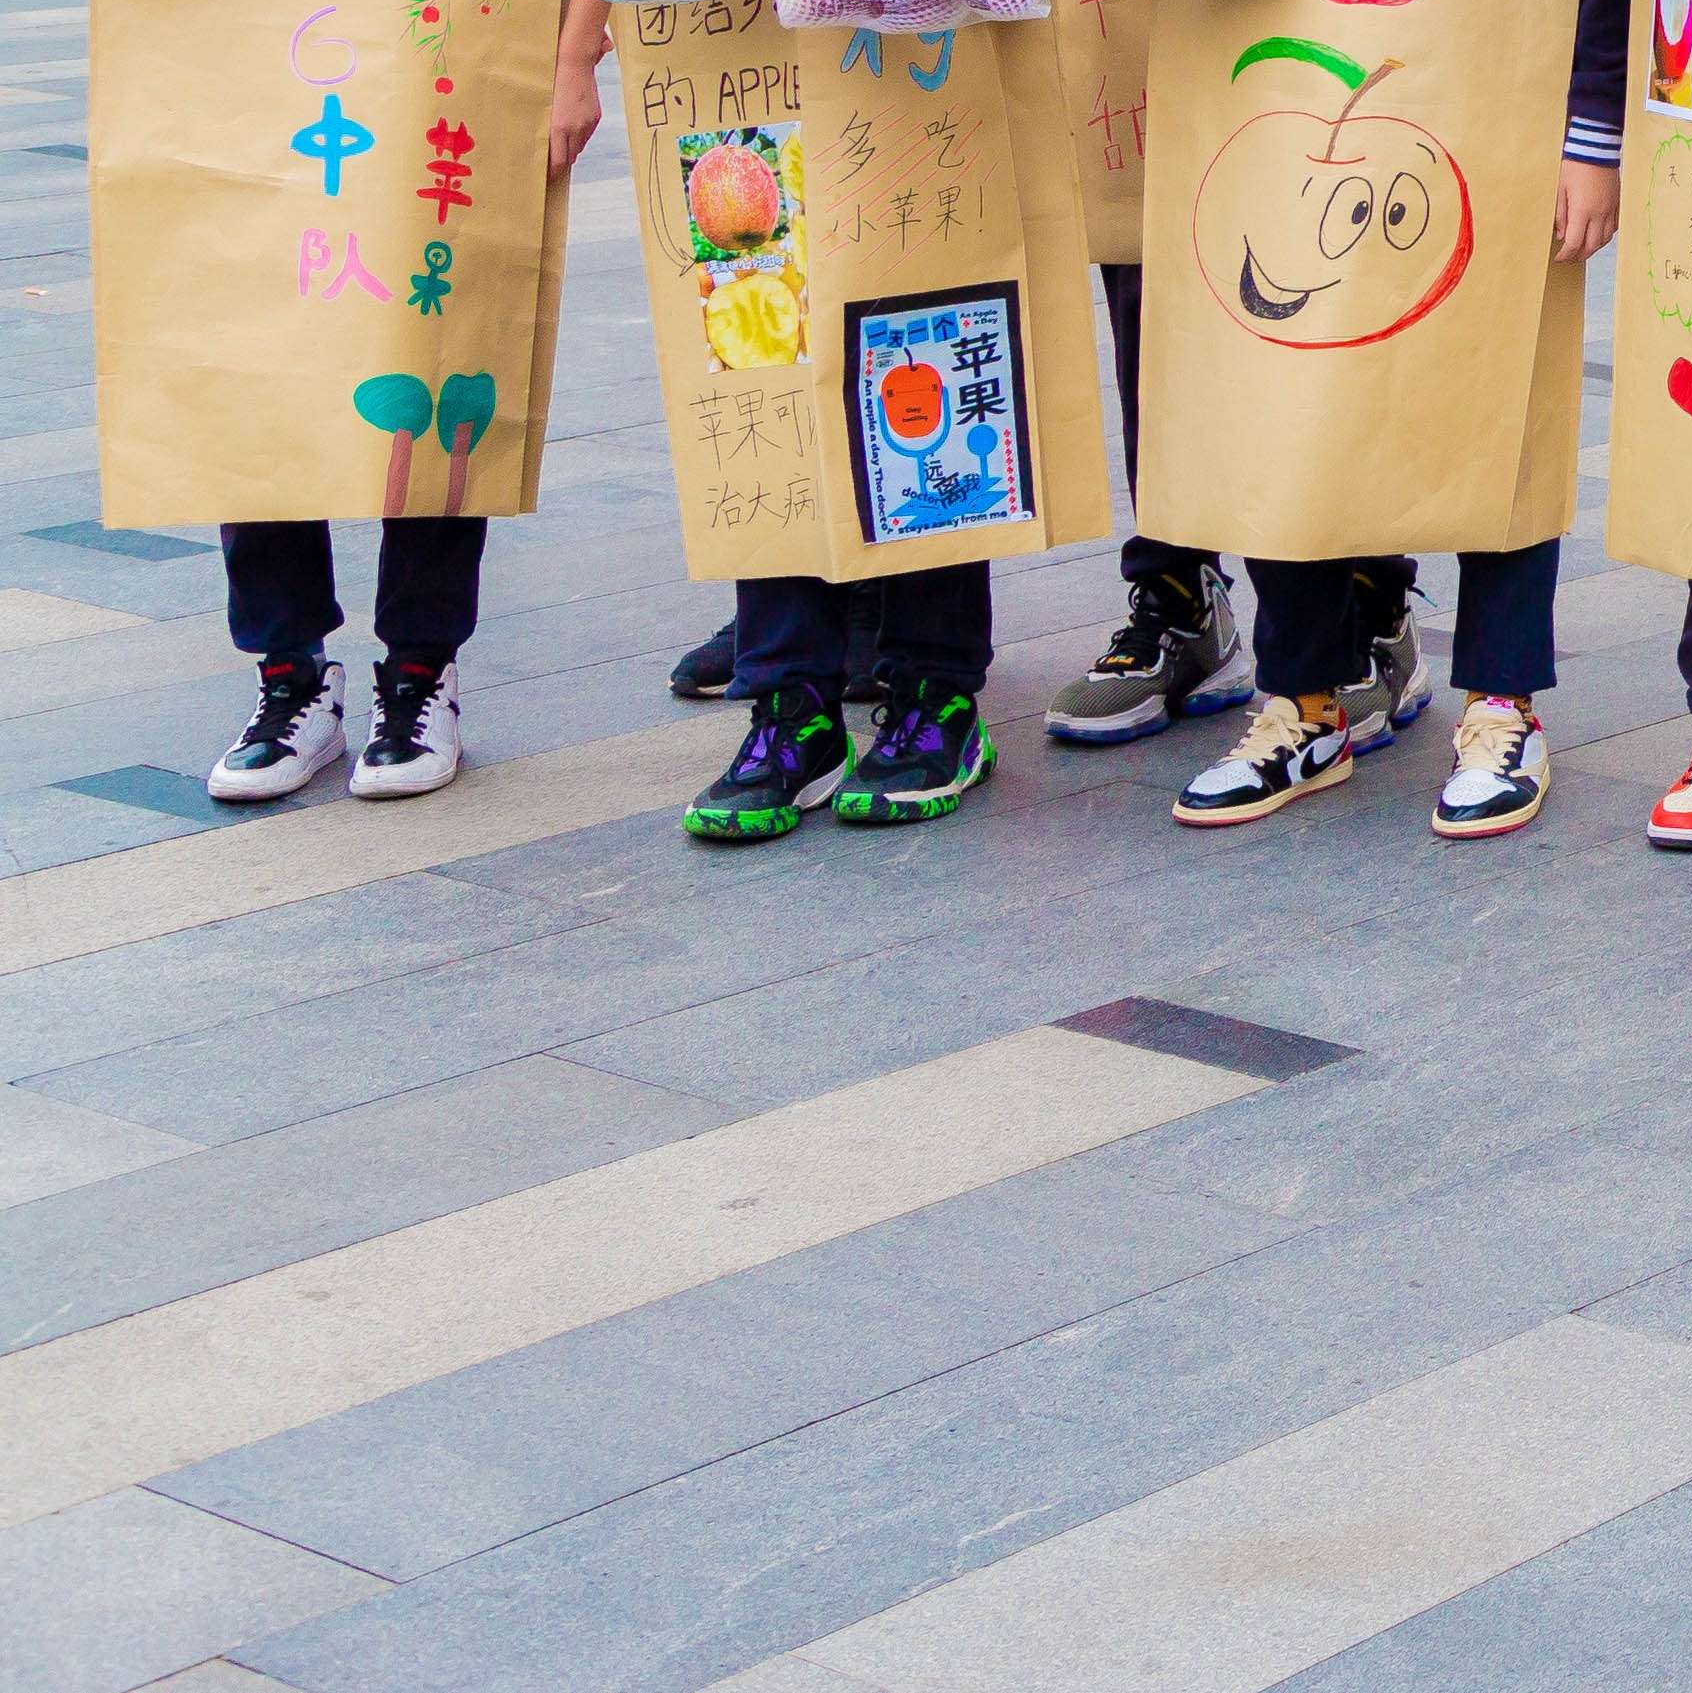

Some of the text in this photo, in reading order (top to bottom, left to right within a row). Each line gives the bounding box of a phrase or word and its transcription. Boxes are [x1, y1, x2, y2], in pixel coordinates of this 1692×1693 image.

[643, 66, 697, 129] 的
[839, 109, 966, 185] 多吃
[950, 331, 1009, 426] 苹果
